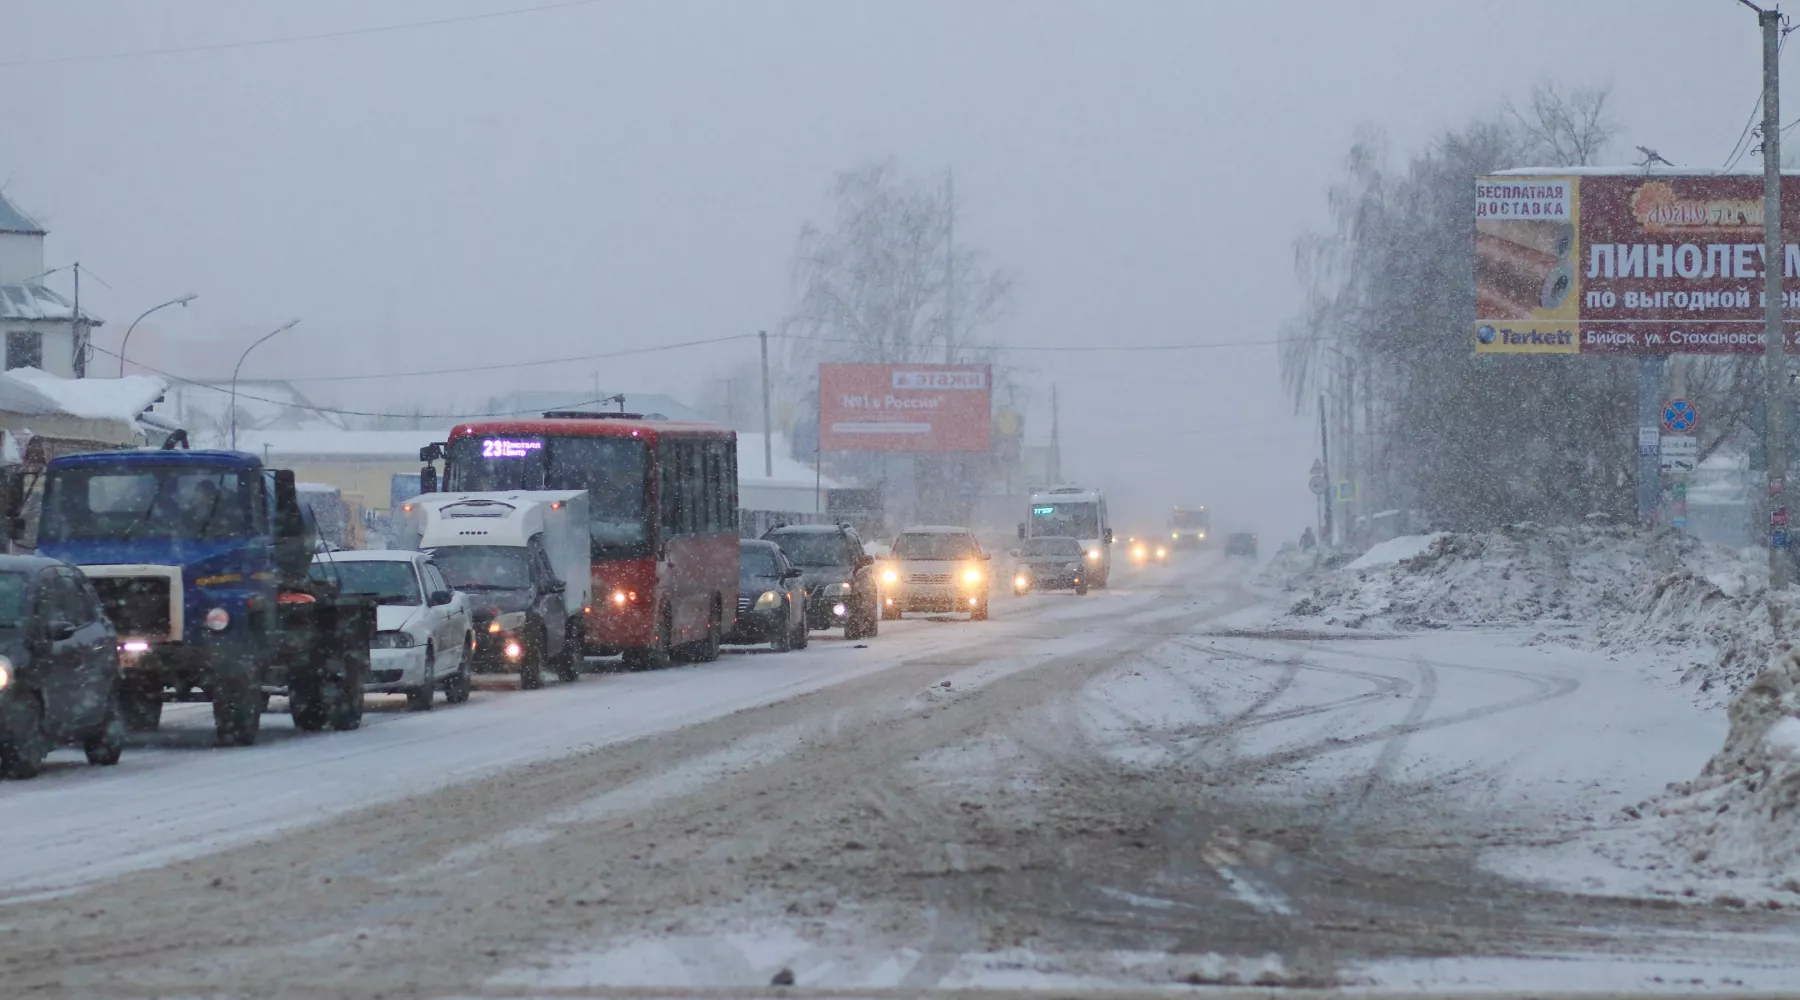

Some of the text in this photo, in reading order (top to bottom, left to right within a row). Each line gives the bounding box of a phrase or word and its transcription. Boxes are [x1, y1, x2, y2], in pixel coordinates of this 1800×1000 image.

[1477, 185, 1563, 199] БЕСПЛАТНАЯ
[1477, 201, 1564, 216] ДОСТАВКА
[1586, 290, 1615, 308] по
[1625, 286, 1749, 312] выгодной
[1501, 328, 1572, 345] Tarkett
[1587, 330, 1640, 346] Бийск,
[1644, 333, 1664, 347] ул.
[483, 440, 502, 456] 23
